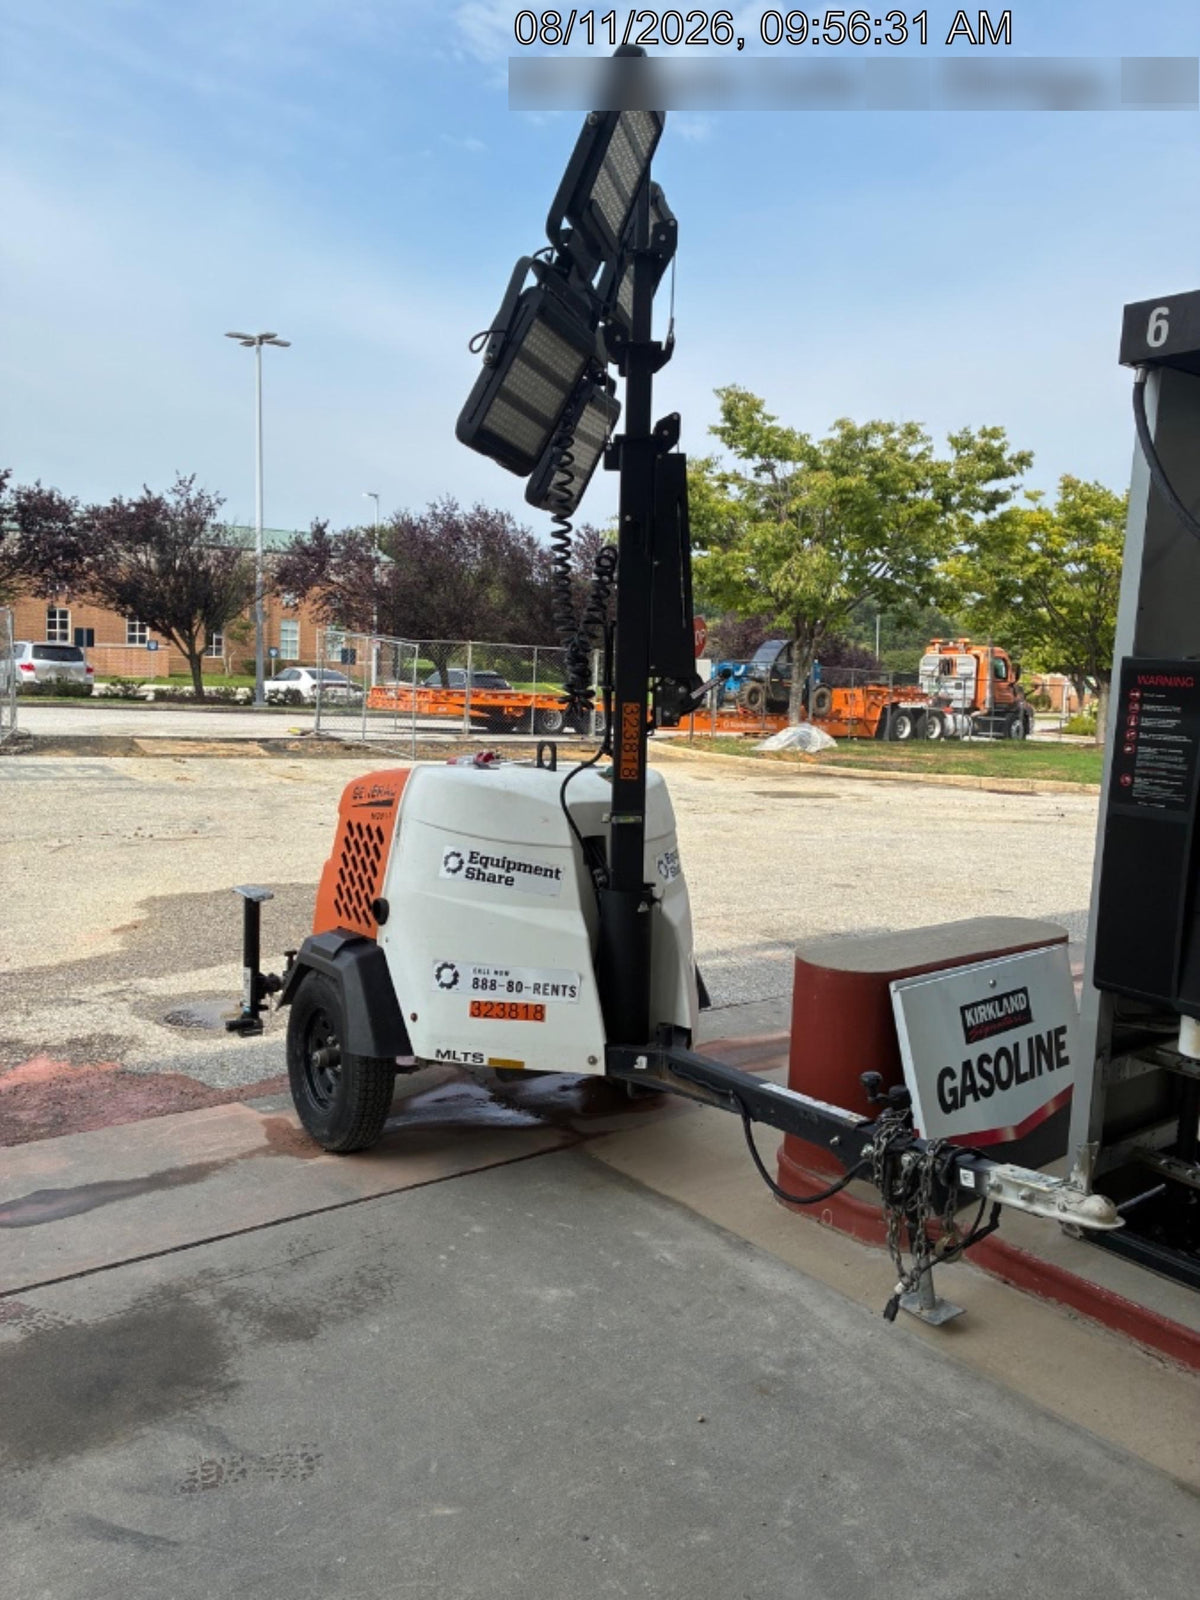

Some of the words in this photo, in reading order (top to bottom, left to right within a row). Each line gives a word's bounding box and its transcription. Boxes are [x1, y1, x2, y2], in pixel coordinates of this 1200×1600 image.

[1146, 306, 1169, 348] 6
[1137, 675, 1195, 688] WARNING
[622, 704, 639, 778] 323818
[465, 866, 515, 886] Share
[468, 851, 562, 880] Equipment
[471, 977, 577, 998] 888-80-RENTS
[470, 1000, 545, 1021] 323818
[964, 993, 1027, 1028] KIRKLAND
[435, 1048, 485, 1064] MLTS
[937, 1025, 1070, 1115] GASOLINE
